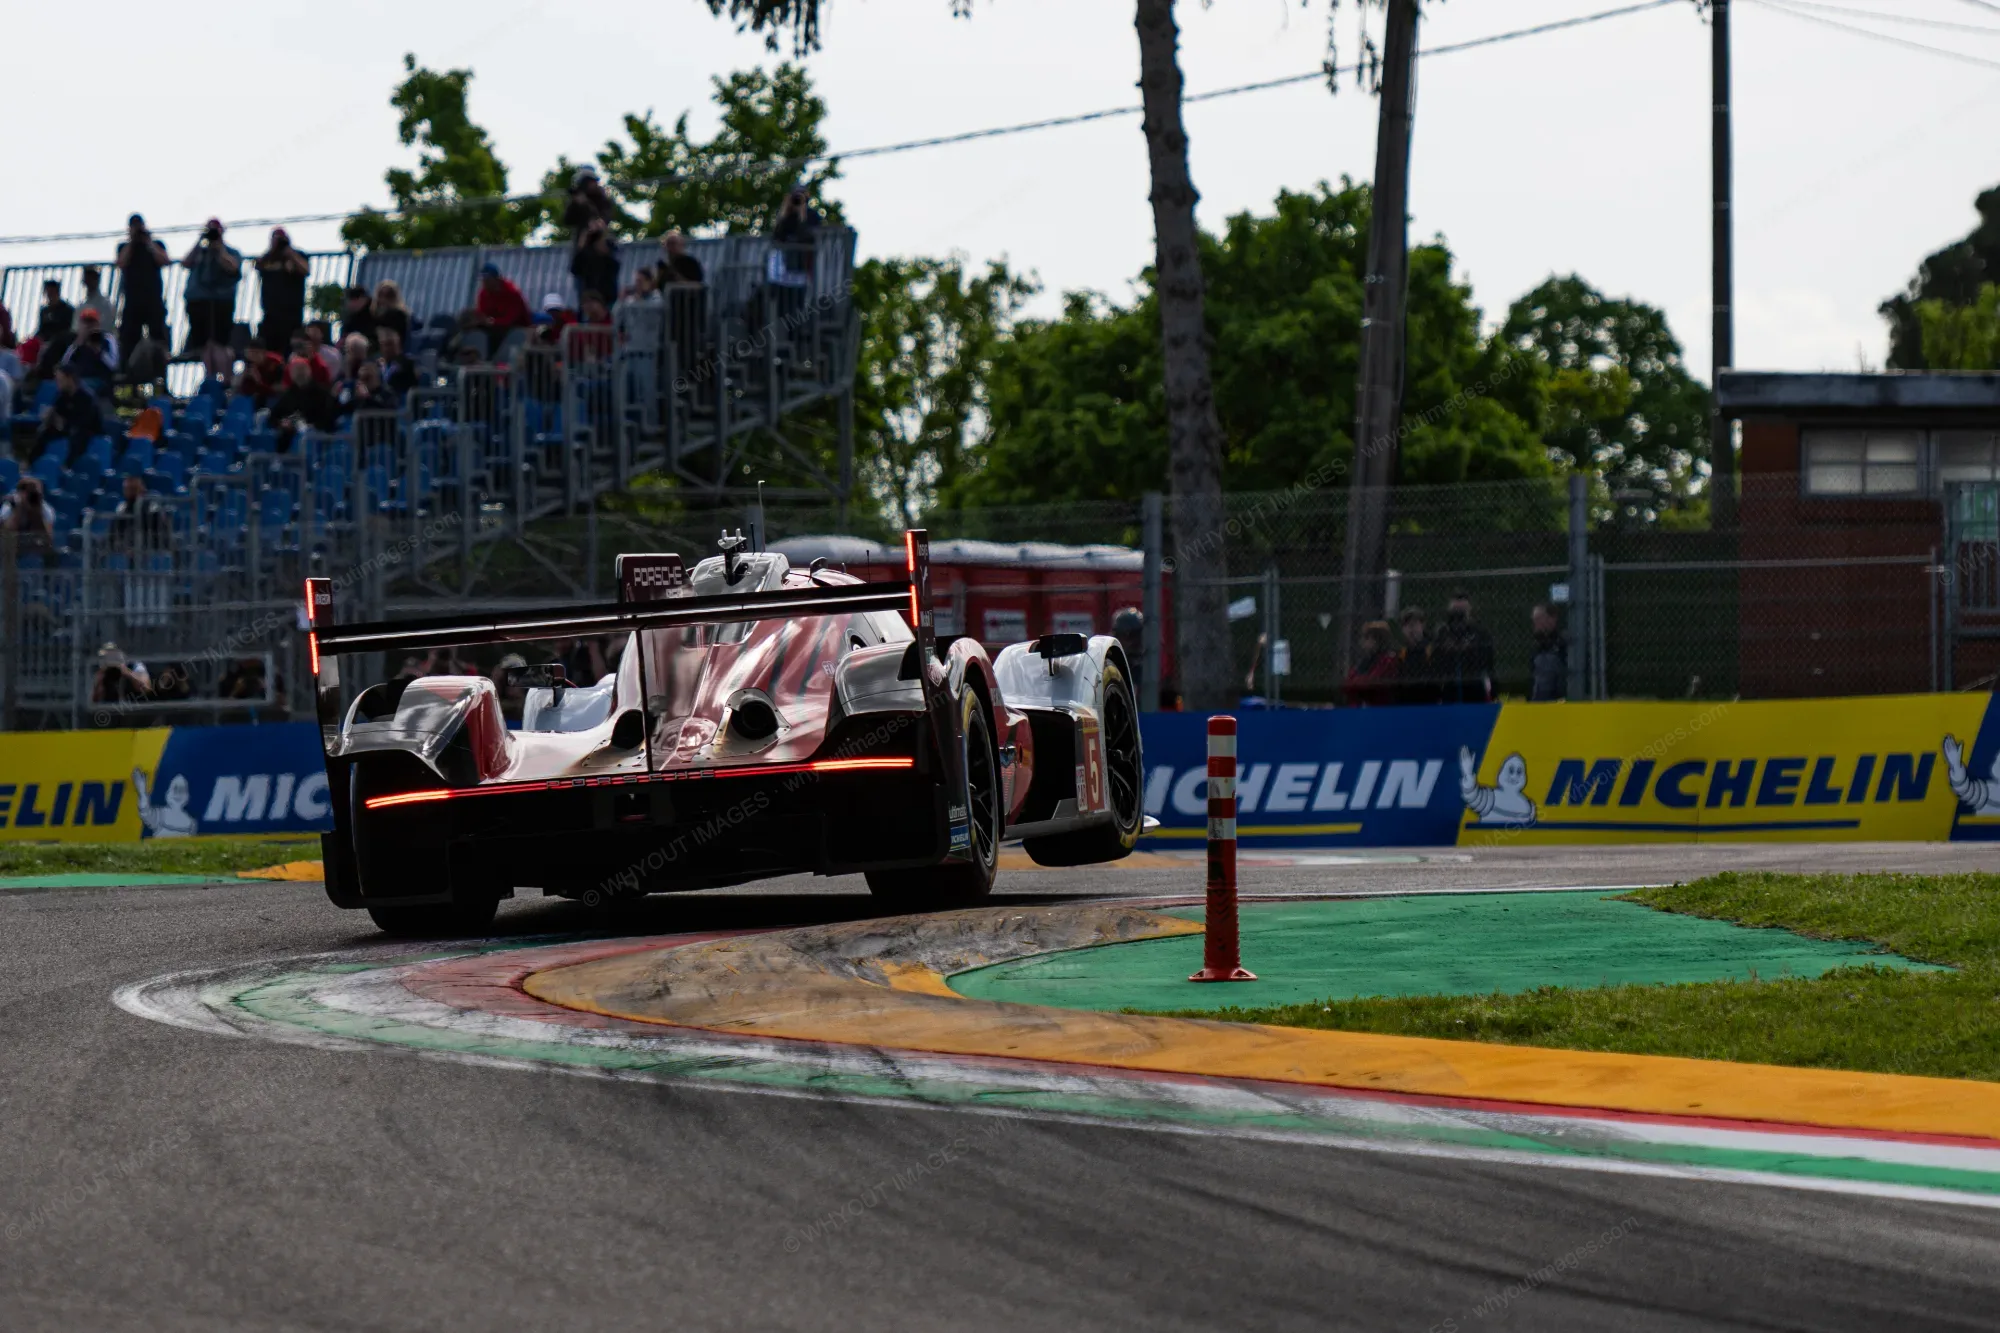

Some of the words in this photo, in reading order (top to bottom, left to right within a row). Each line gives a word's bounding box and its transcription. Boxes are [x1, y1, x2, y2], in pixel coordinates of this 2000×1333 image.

[633, 566, 682, 587] PORSCHE
[1089, 738, 1100, 804] 5
[1544, 752, 1937, 809] MICHELIN
